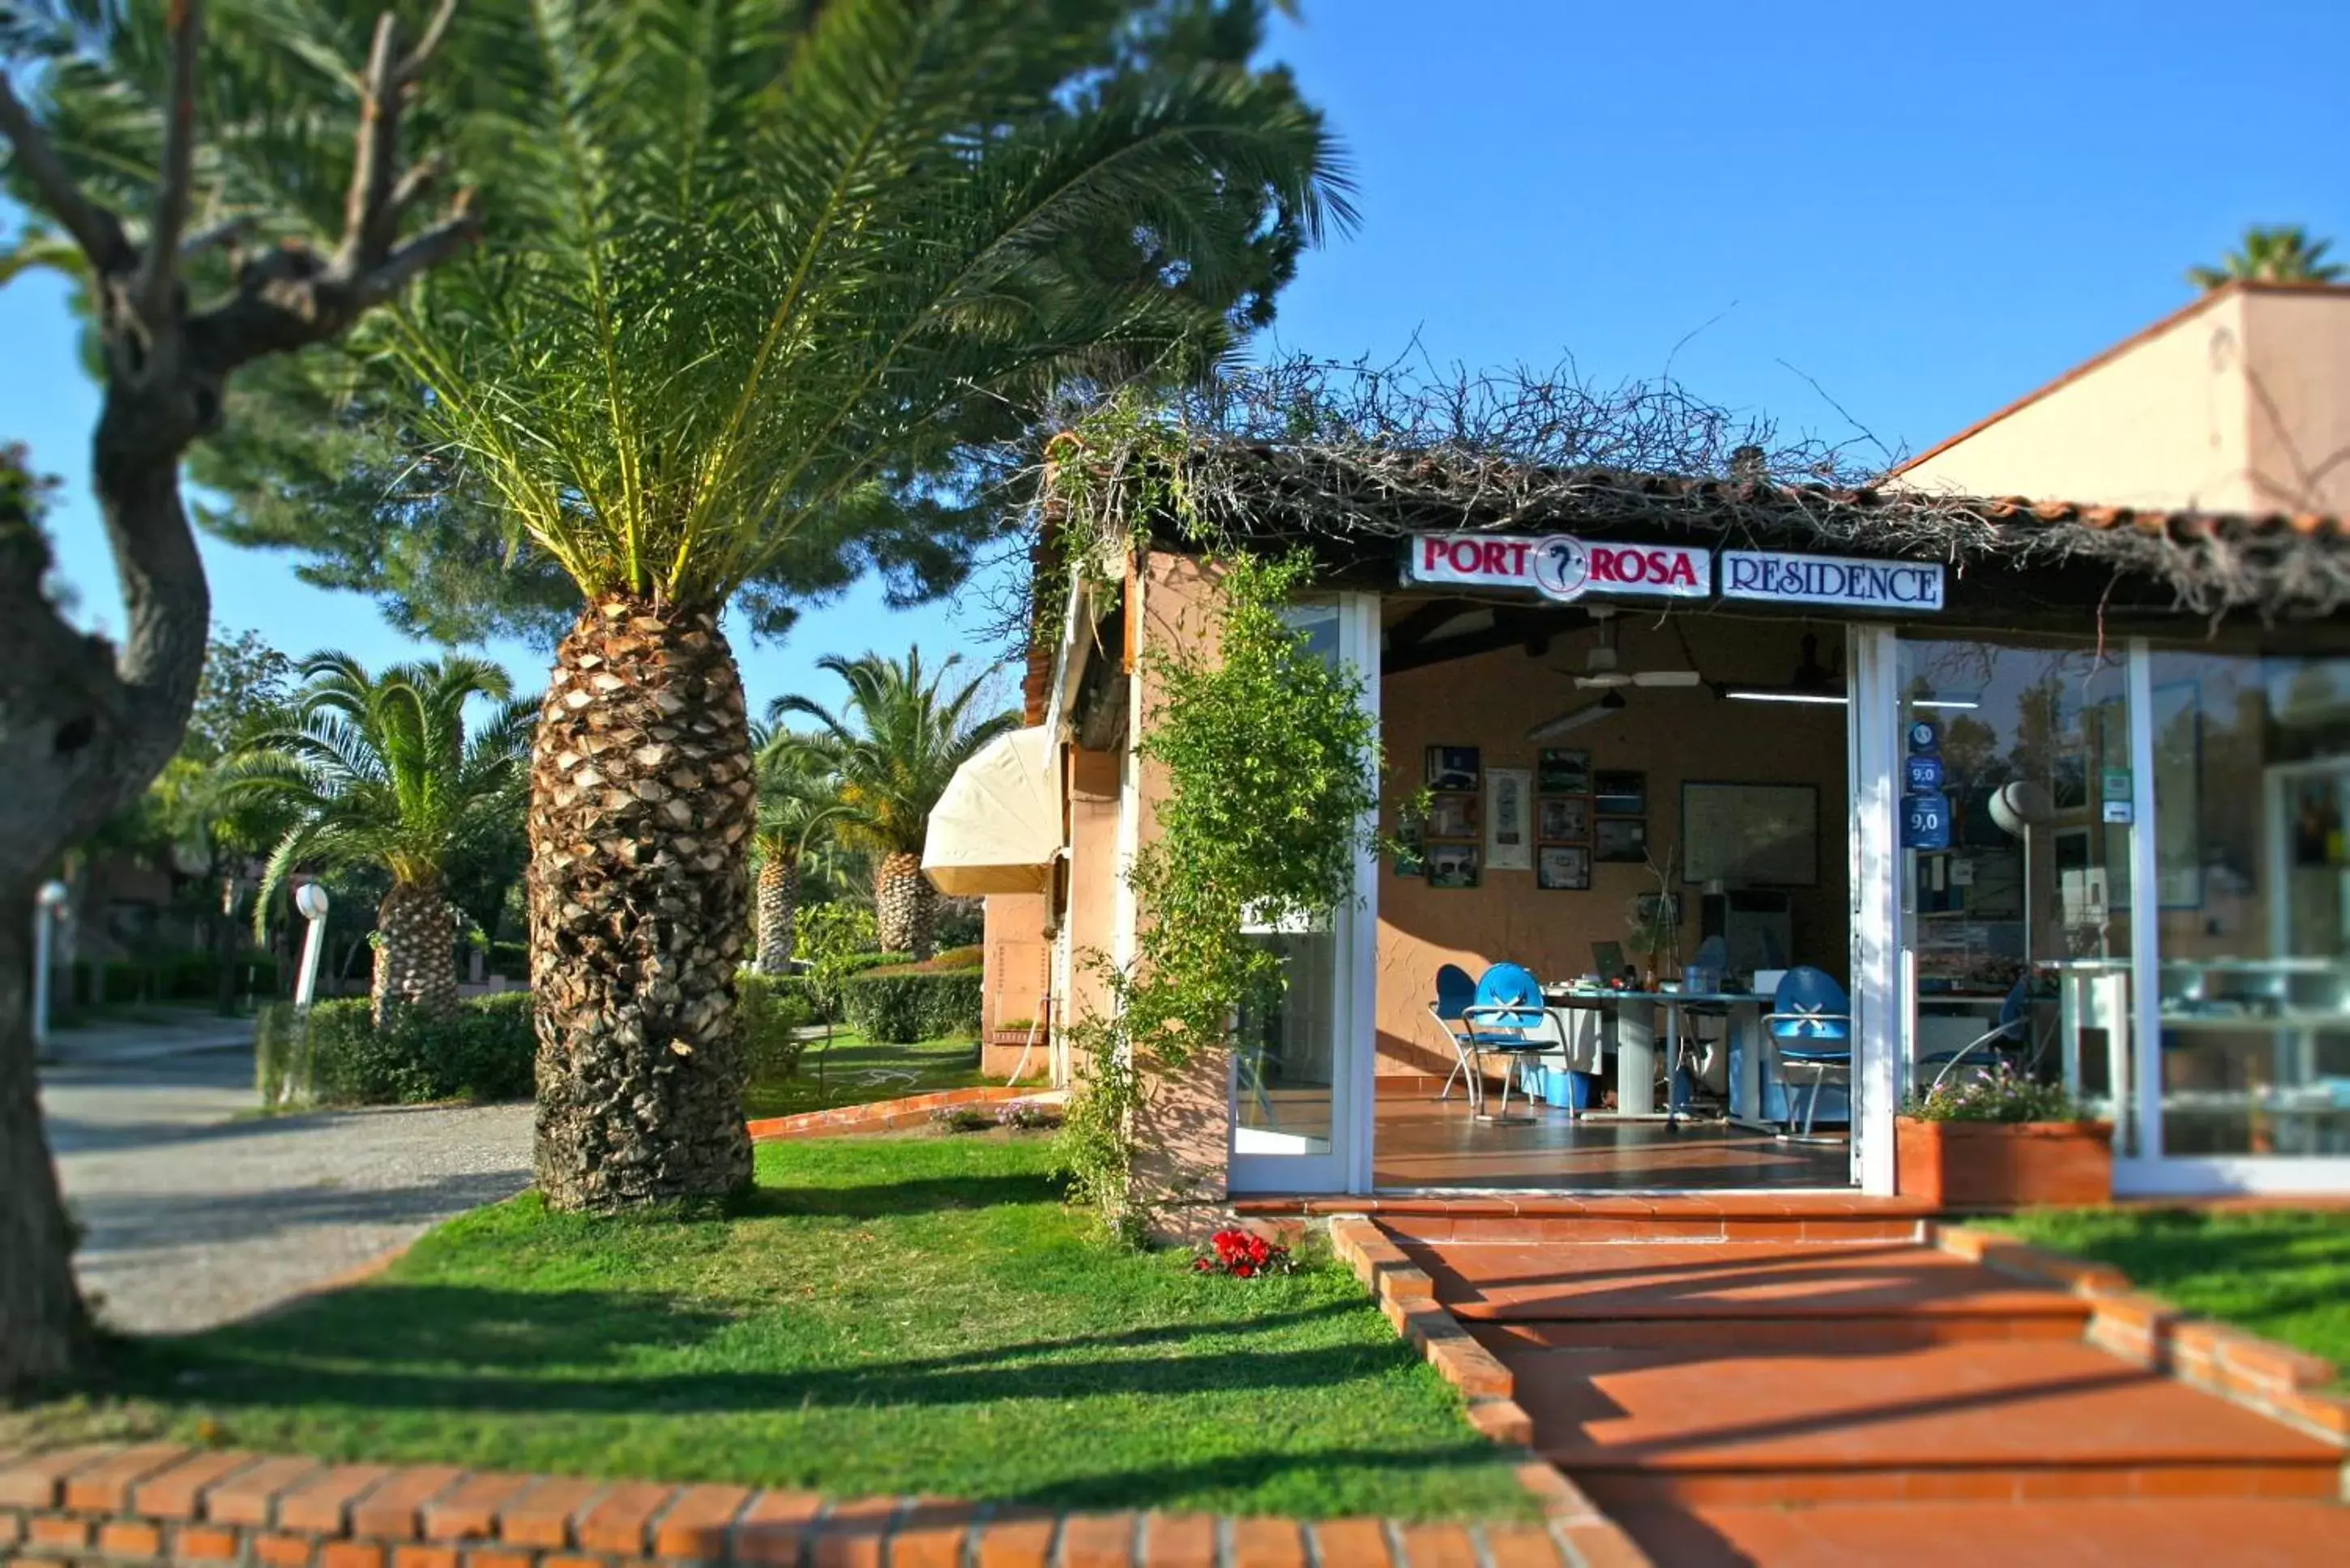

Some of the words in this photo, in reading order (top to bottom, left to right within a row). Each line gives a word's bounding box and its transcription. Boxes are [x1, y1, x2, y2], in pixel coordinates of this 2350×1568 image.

[1425, 537, 1532, 576] PORT
[1590, 548, 1698, 586] ROSA
[1728, 557, 1937, 605] RESIDENCE
[1912, 814, 1938, 832] 9,0
